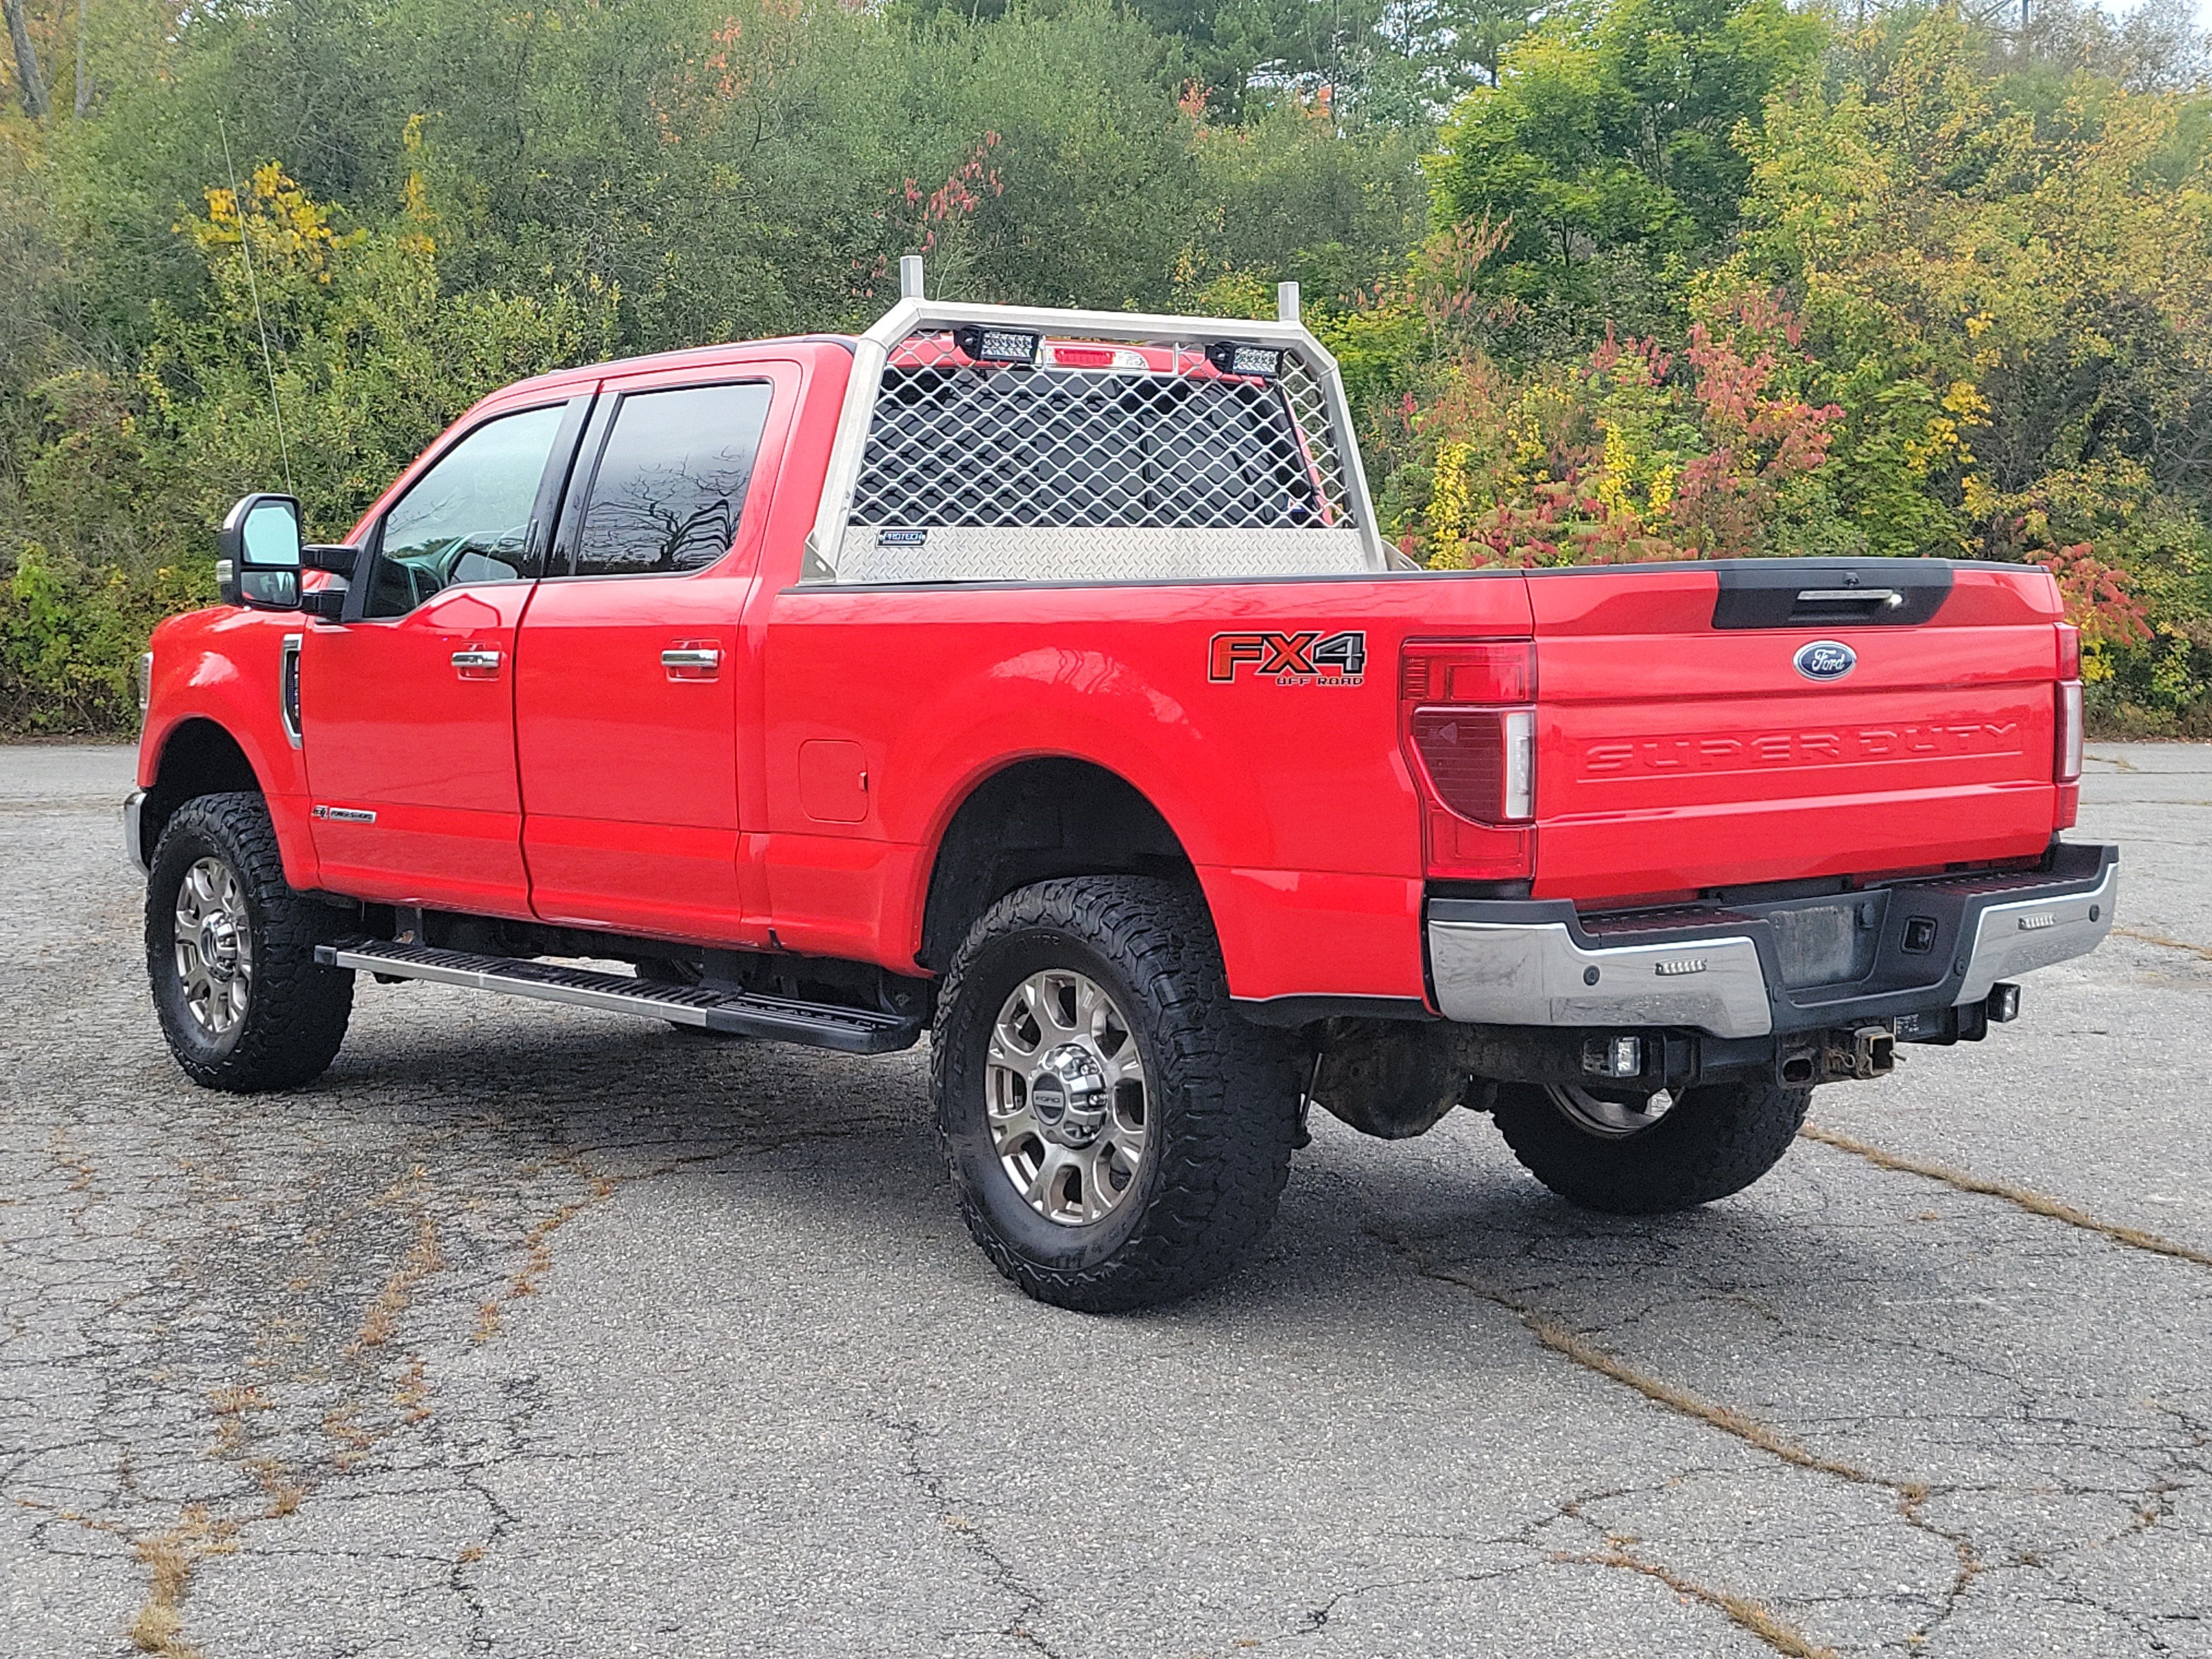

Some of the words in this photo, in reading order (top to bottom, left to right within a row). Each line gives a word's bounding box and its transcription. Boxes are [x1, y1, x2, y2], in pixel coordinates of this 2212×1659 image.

[1208, 631, 1366, 682] FX4
[1812, 648, 1845, 671] Ford
[1277, 676, 1310, 686] OFF
[1317, 676, 1363, 686] ROAD
[1586, 733, 1840, 772] SUPER
[1858, 722, 2018, 756] DUTY
